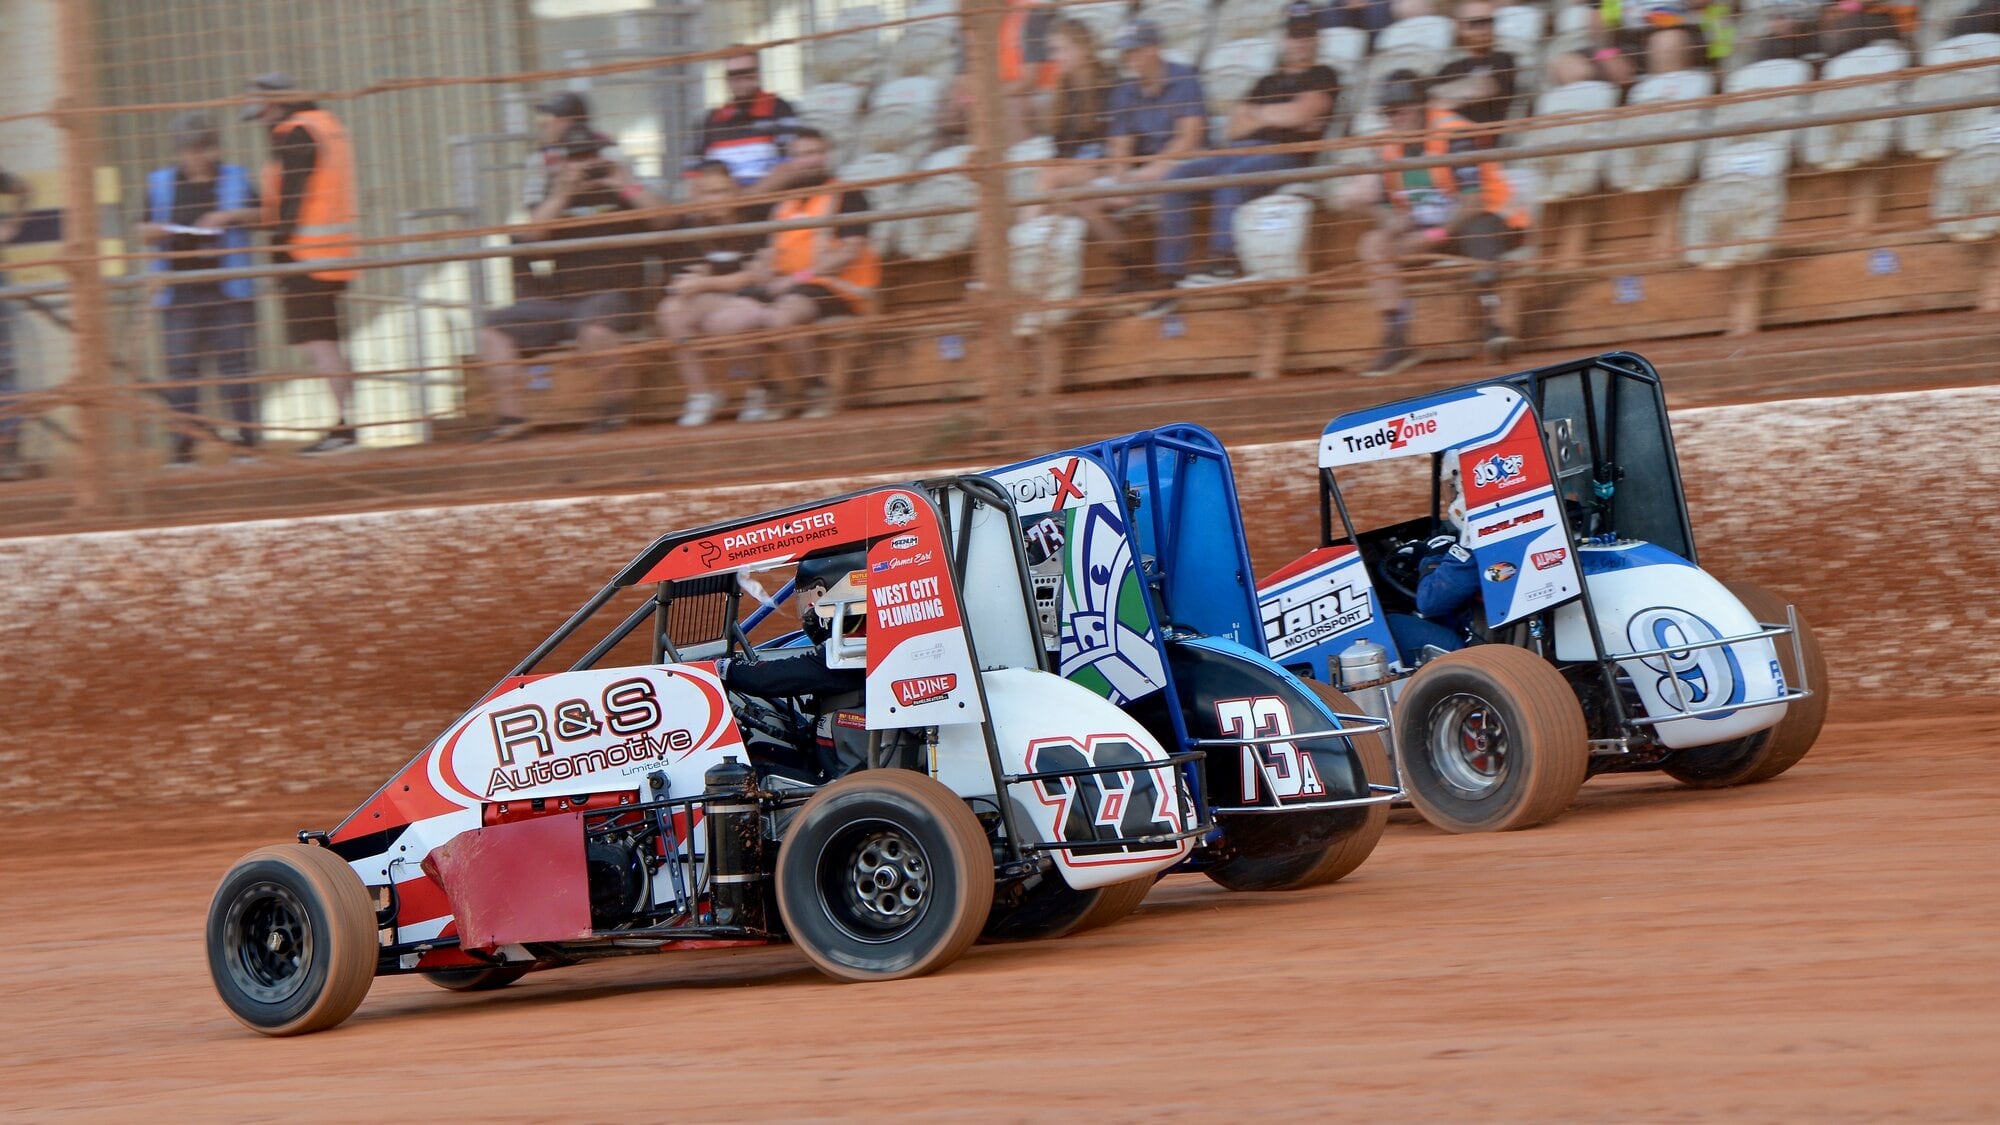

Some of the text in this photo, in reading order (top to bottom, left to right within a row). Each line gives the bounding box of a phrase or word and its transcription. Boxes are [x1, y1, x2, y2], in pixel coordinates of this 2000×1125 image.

[1343, 418, 1438, 453] TradeZone
[724, 511, 836, 551] PARTMASTER
[728, 527, 839, 562] SMARTER AUTO PARTS
[889, 550, 932, 570] James Earl
[872, 576, 939, 608] WEST CITY
[878, 598, 945, 629] PLUMBING
[1285, 610, 1361, 648] MOTORSPORT
[1627, 606, 1746, 720] 9
[902, 676, 950, 702] ALPINE
[486, 729, 692, 797] Automotive
[621, 758, 670, 777] Limited
